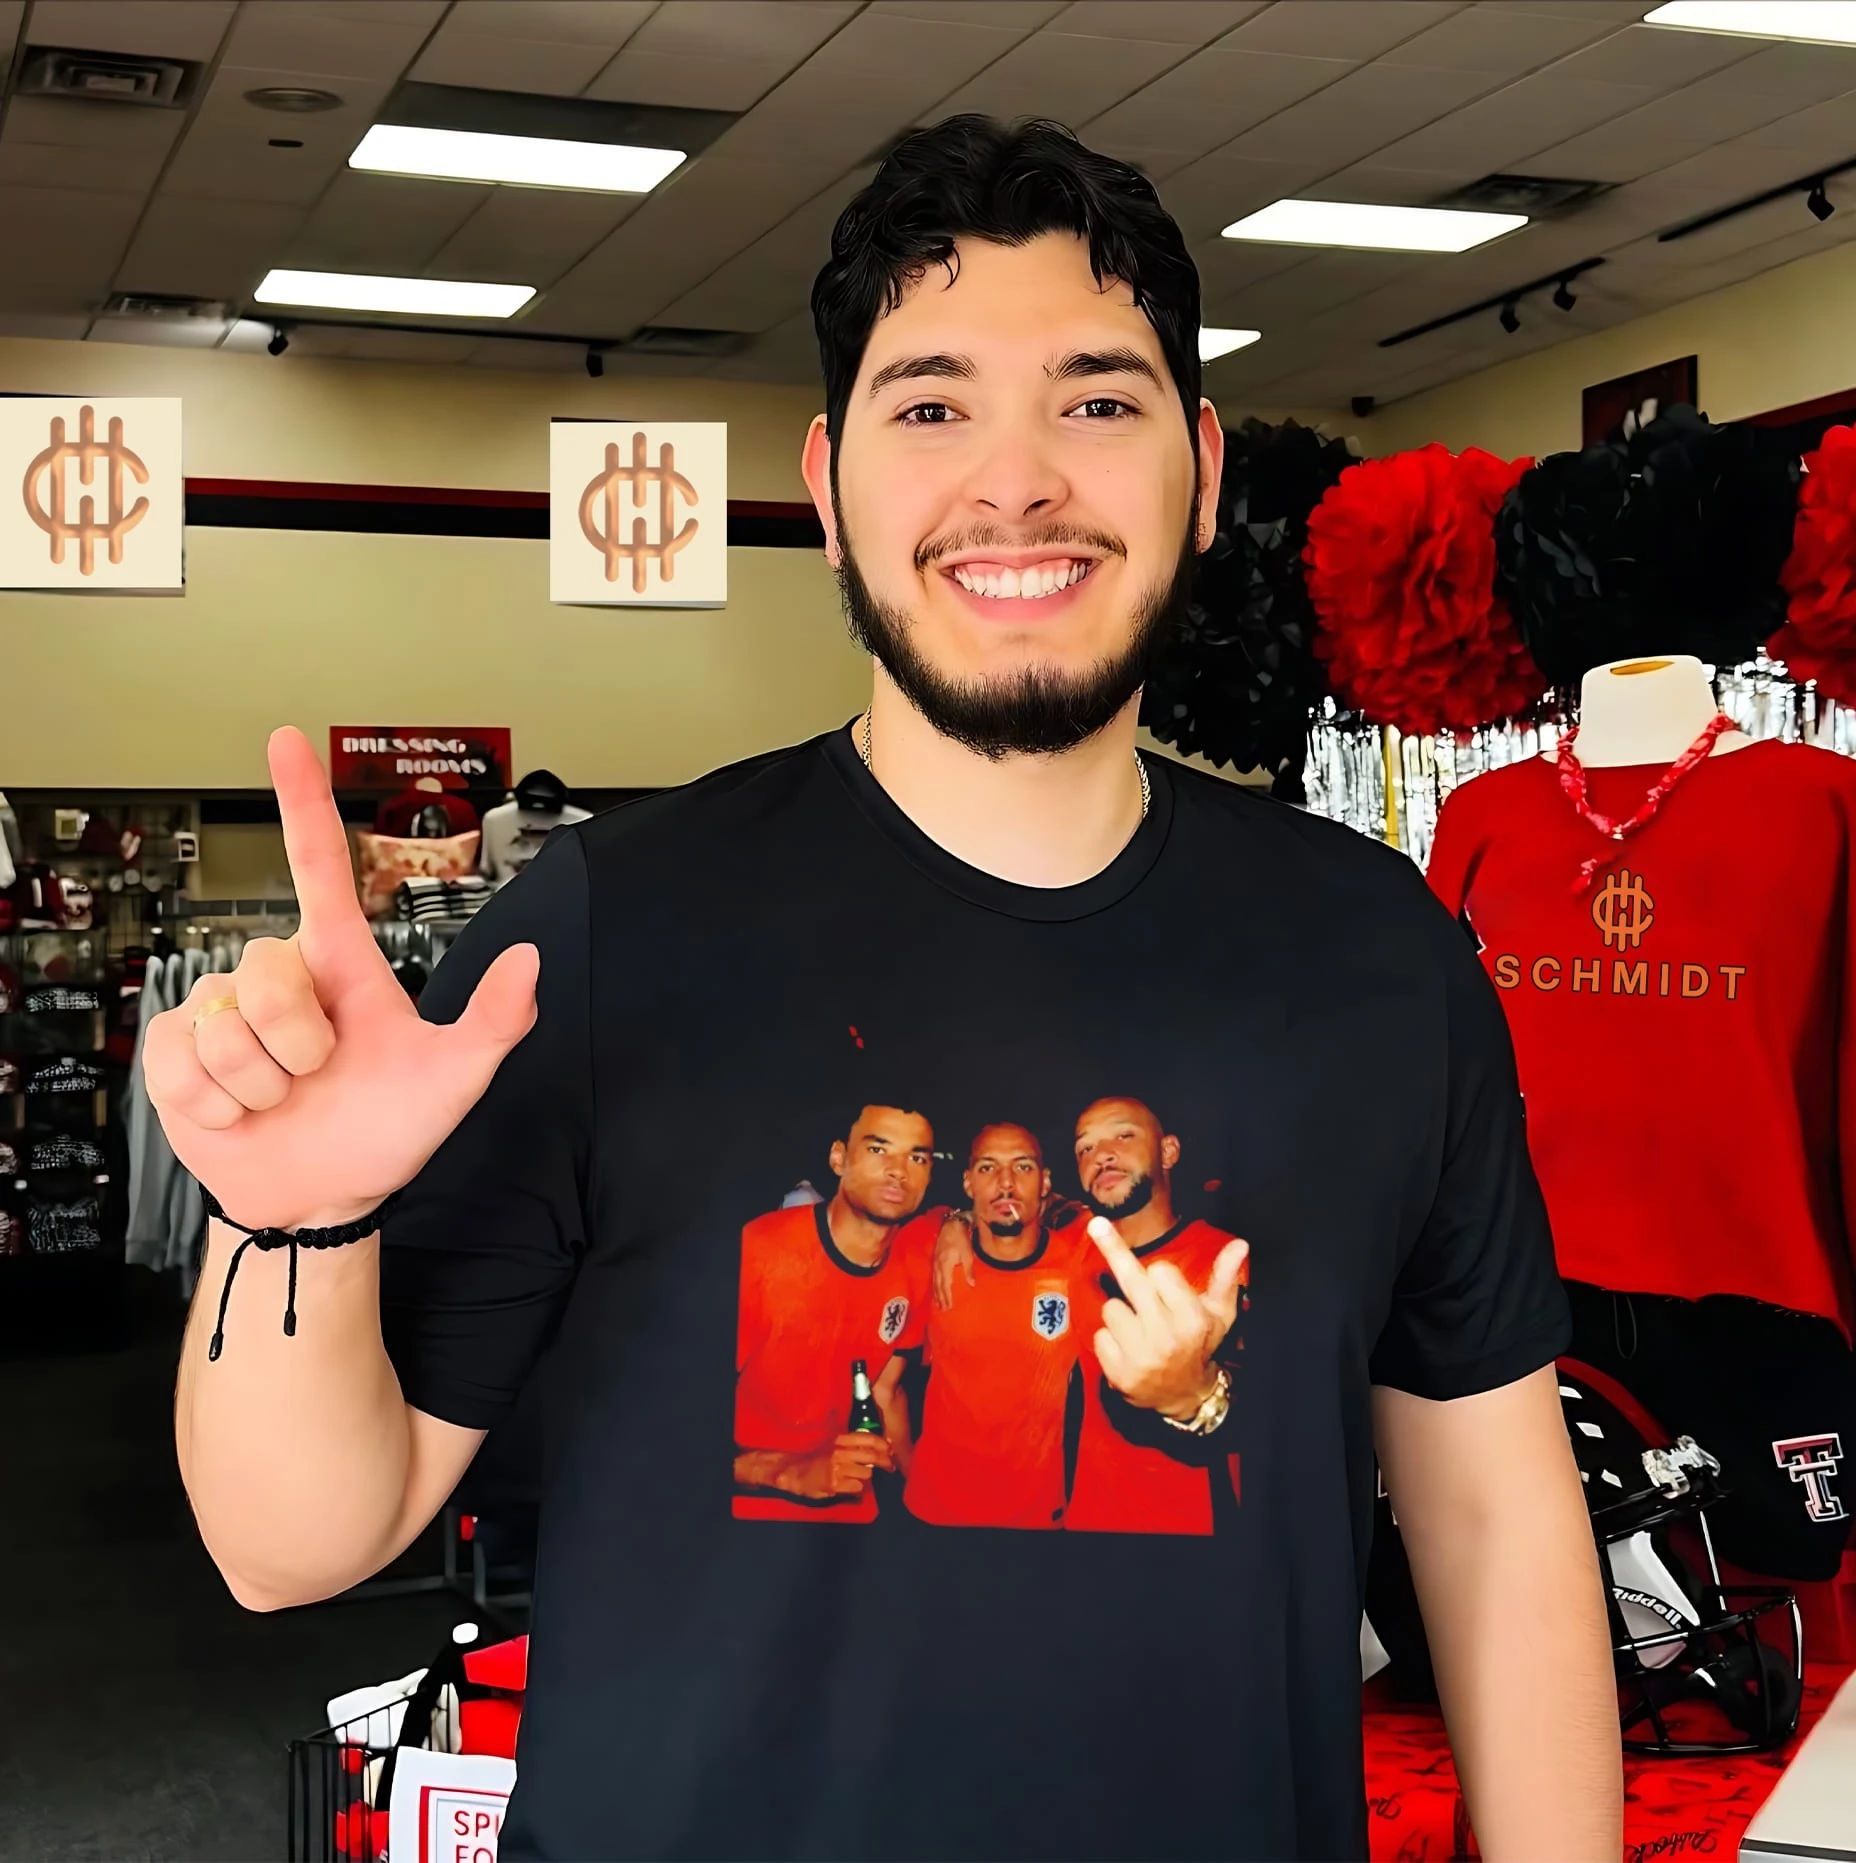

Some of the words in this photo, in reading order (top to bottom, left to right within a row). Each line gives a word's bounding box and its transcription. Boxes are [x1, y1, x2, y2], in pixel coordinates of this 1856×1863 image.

[342, 737, 467, 754] DRESSING
[395, 758, 487, 775] ROOMS
[1493, 954, 1747, 1000] SCHMIDT
